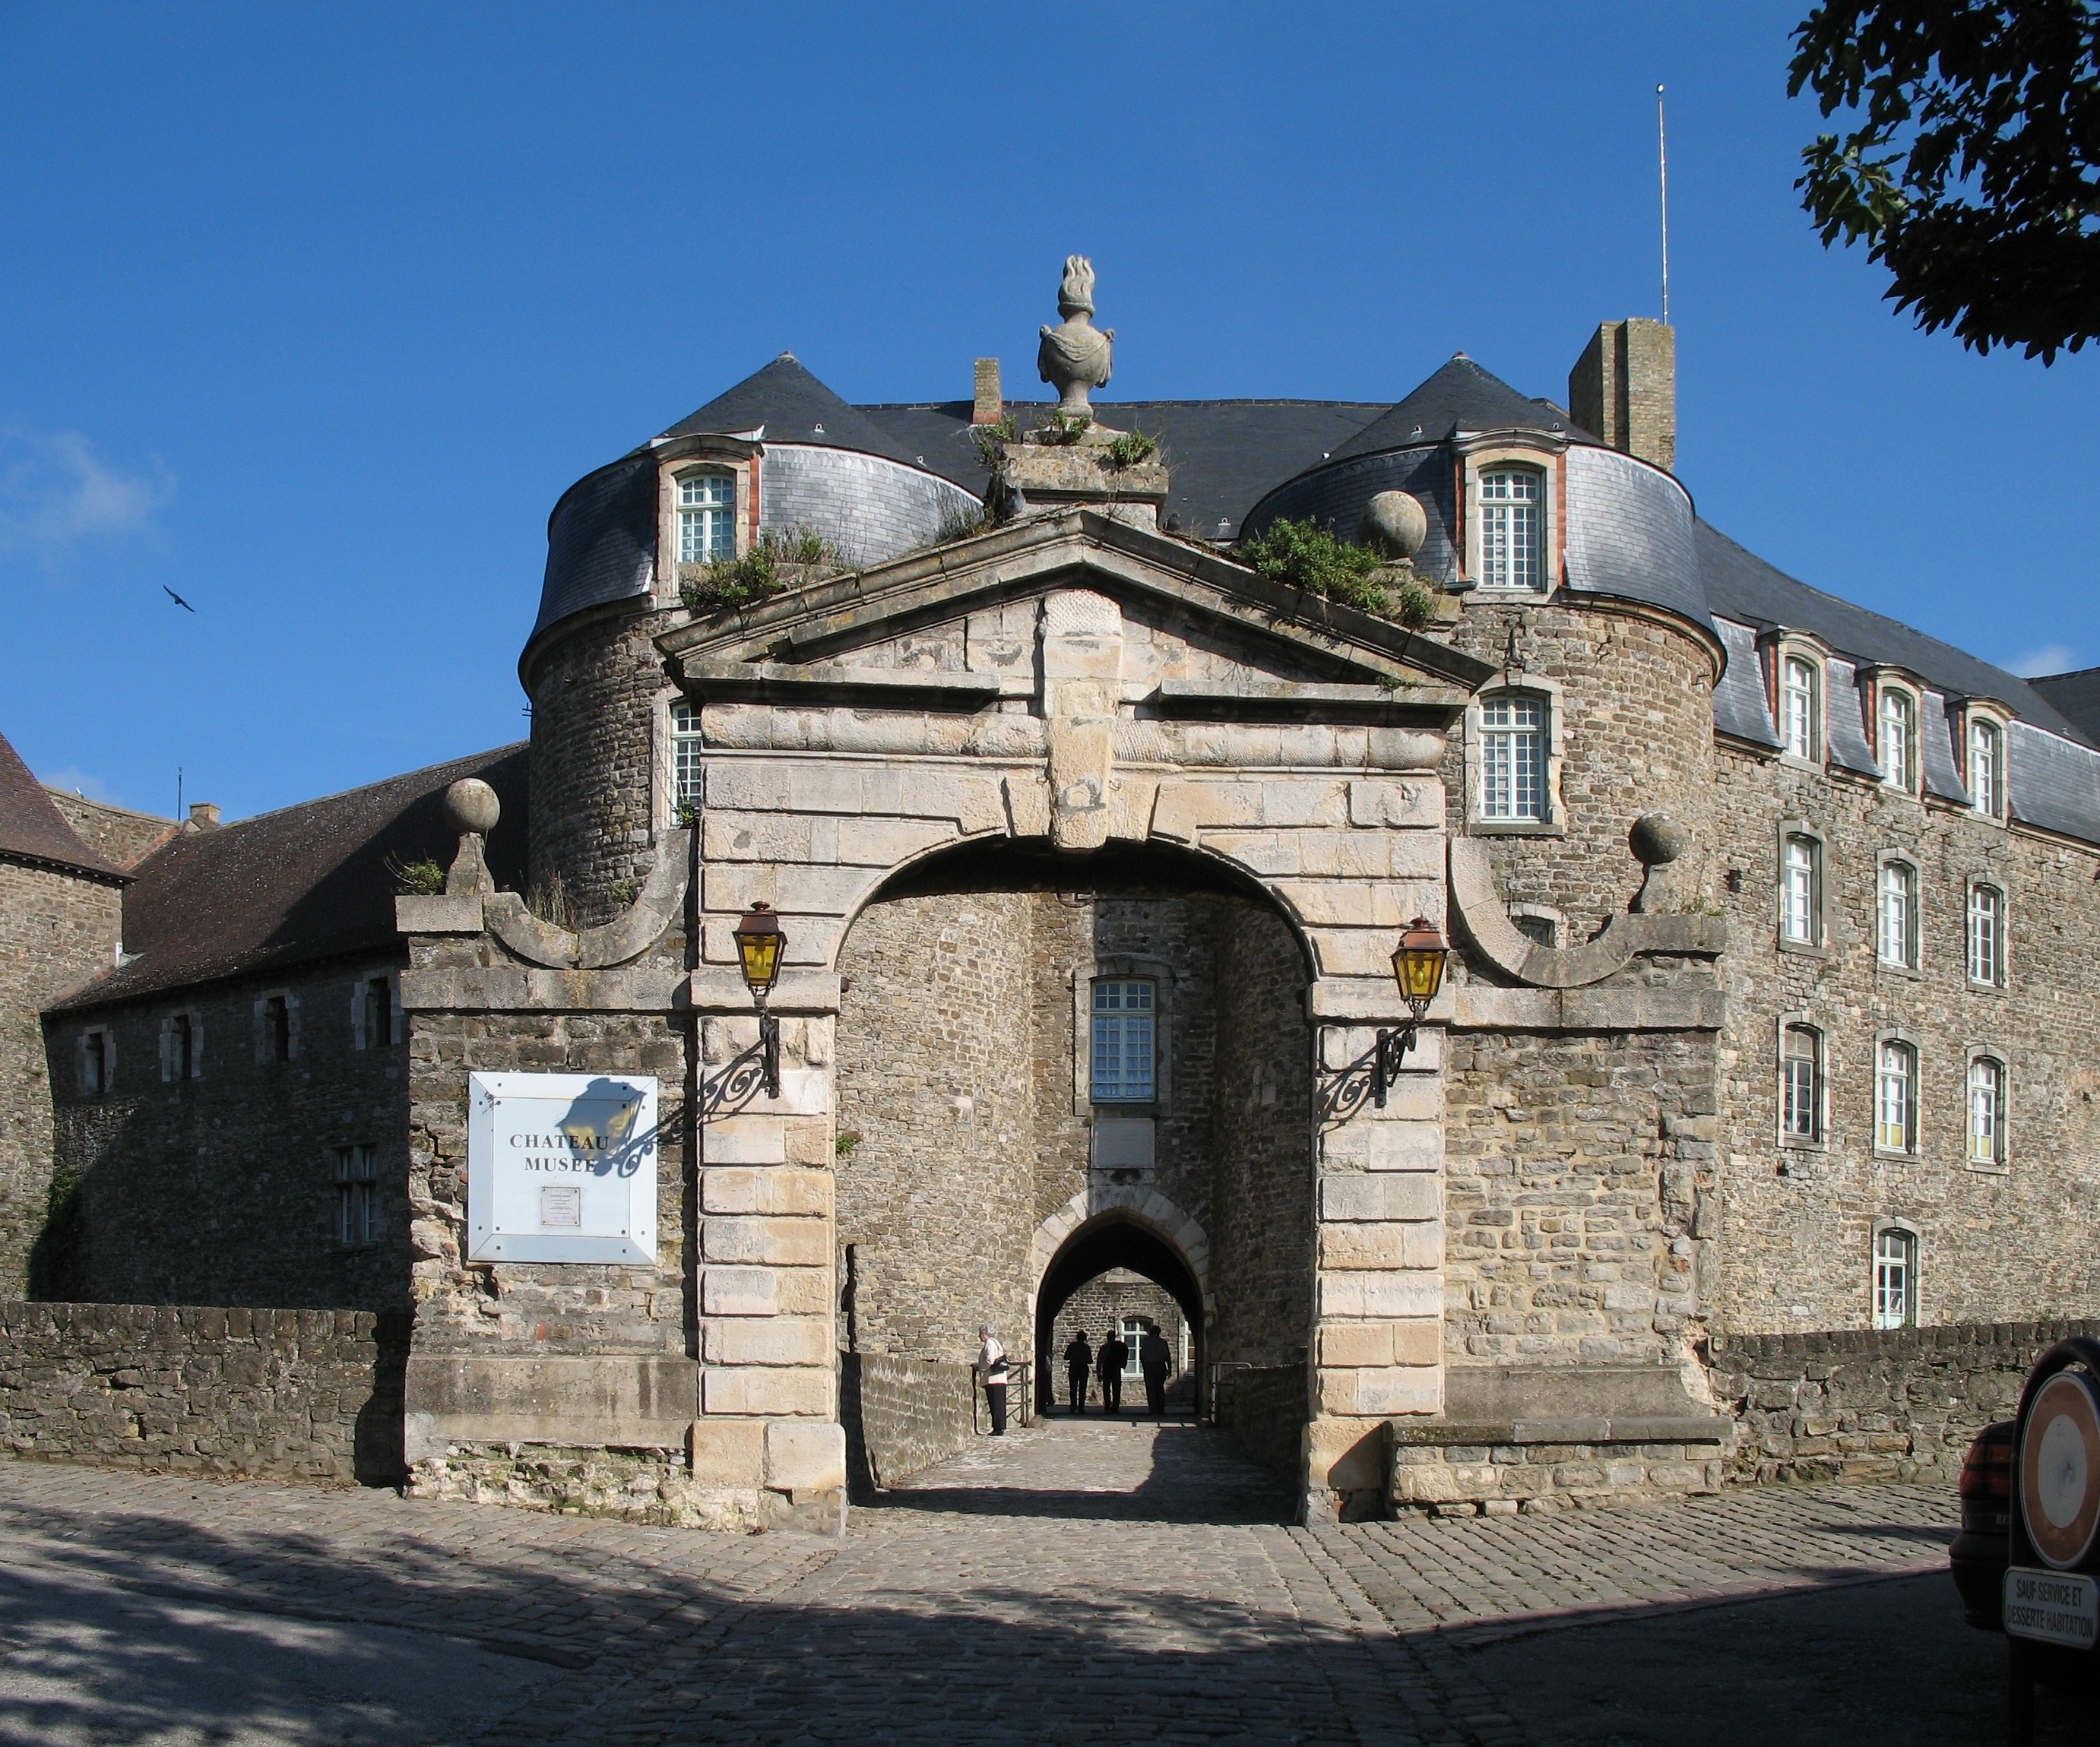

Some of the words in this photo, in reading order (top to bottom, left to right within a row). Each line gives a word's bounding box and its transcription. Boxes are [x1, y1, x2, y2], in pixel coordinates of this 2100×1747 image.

[510, 1134, 609, 1150] CHATEAU
[524, 1157, 597, 1173] MUSEE
[2016, 1579, 2036, 1600] SAUF
[2038, 1582, 2070, 1605] SERVICE
[2073, 1587, 2083, 1606] ET
[2007, 1605, 2045, 1629] DESSERTE
[2047, 1611, 2092, 1638] HABITATION
